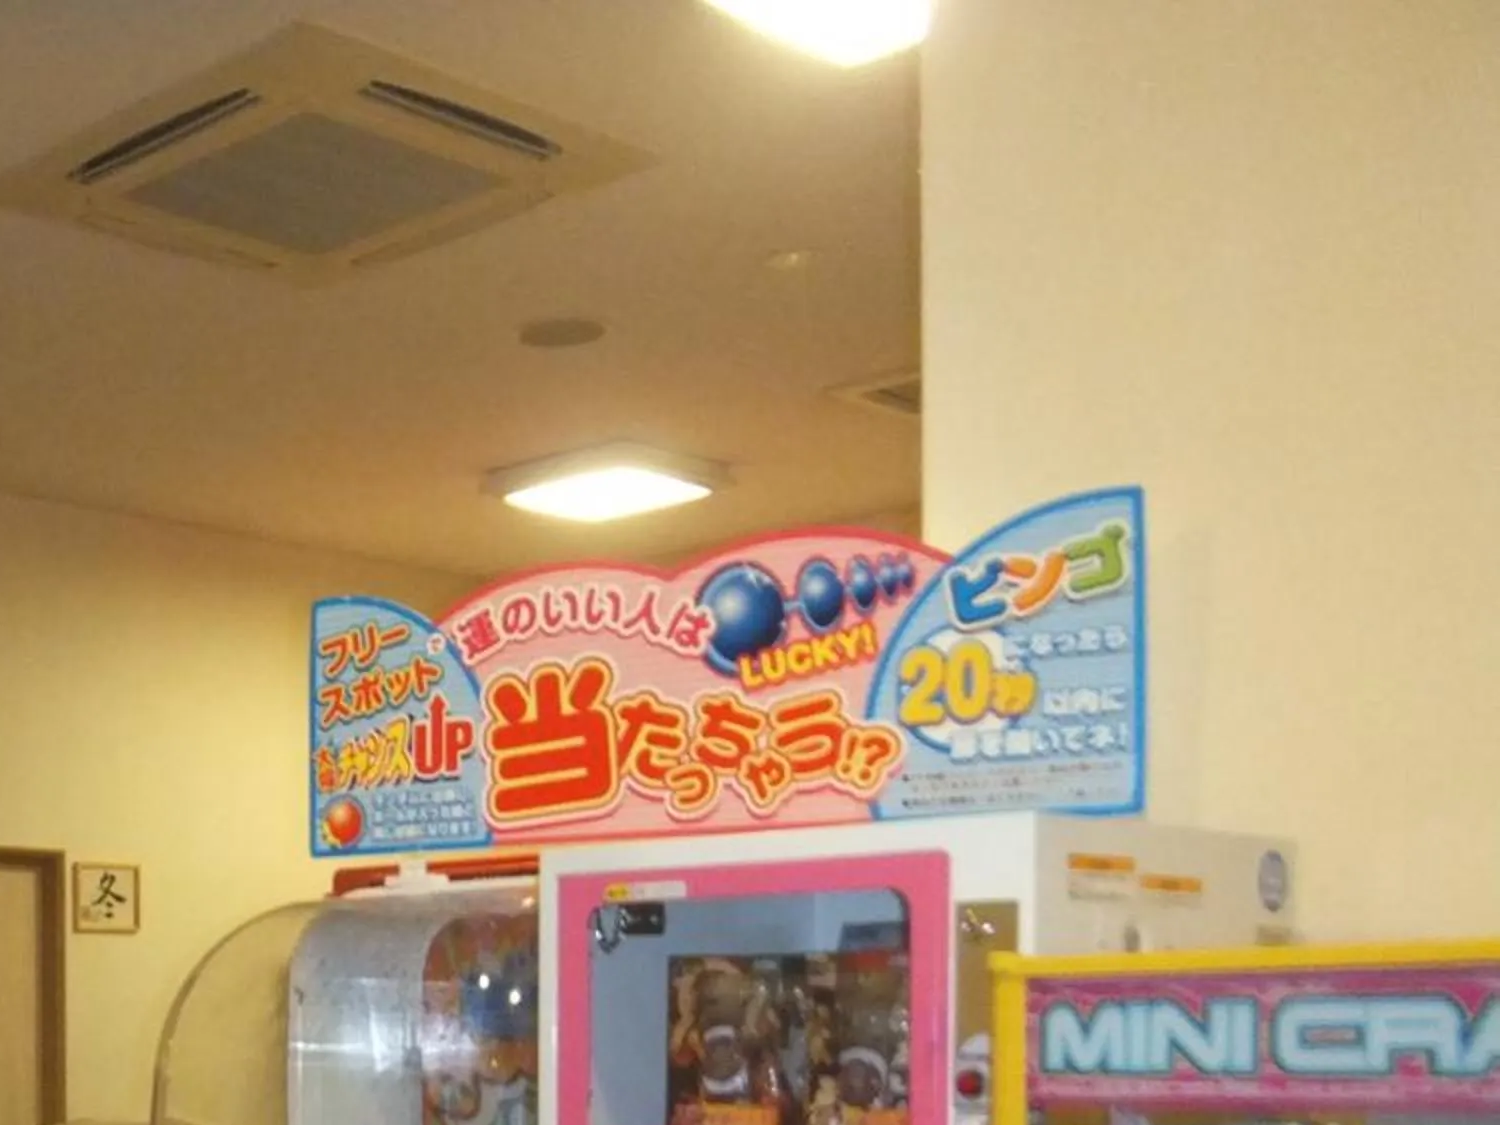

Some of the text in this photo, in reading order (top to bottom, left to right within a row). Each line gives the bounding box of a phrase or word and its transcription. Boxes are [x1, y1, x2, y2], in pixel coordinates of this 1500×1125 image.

[949, 523, 1126, 624] ビンゴ
[320, 622, 409, 677] フリー
[455, 586, 713, 661] 運のいい人は
[738, 619, 880, 691] LUCKY!
[320, 657, 442, 728] スポット
[413, 695, 474, 780] UP
[91, 871, 128, 920] 冬
[1041, 997, 1258, 1074] MINI
